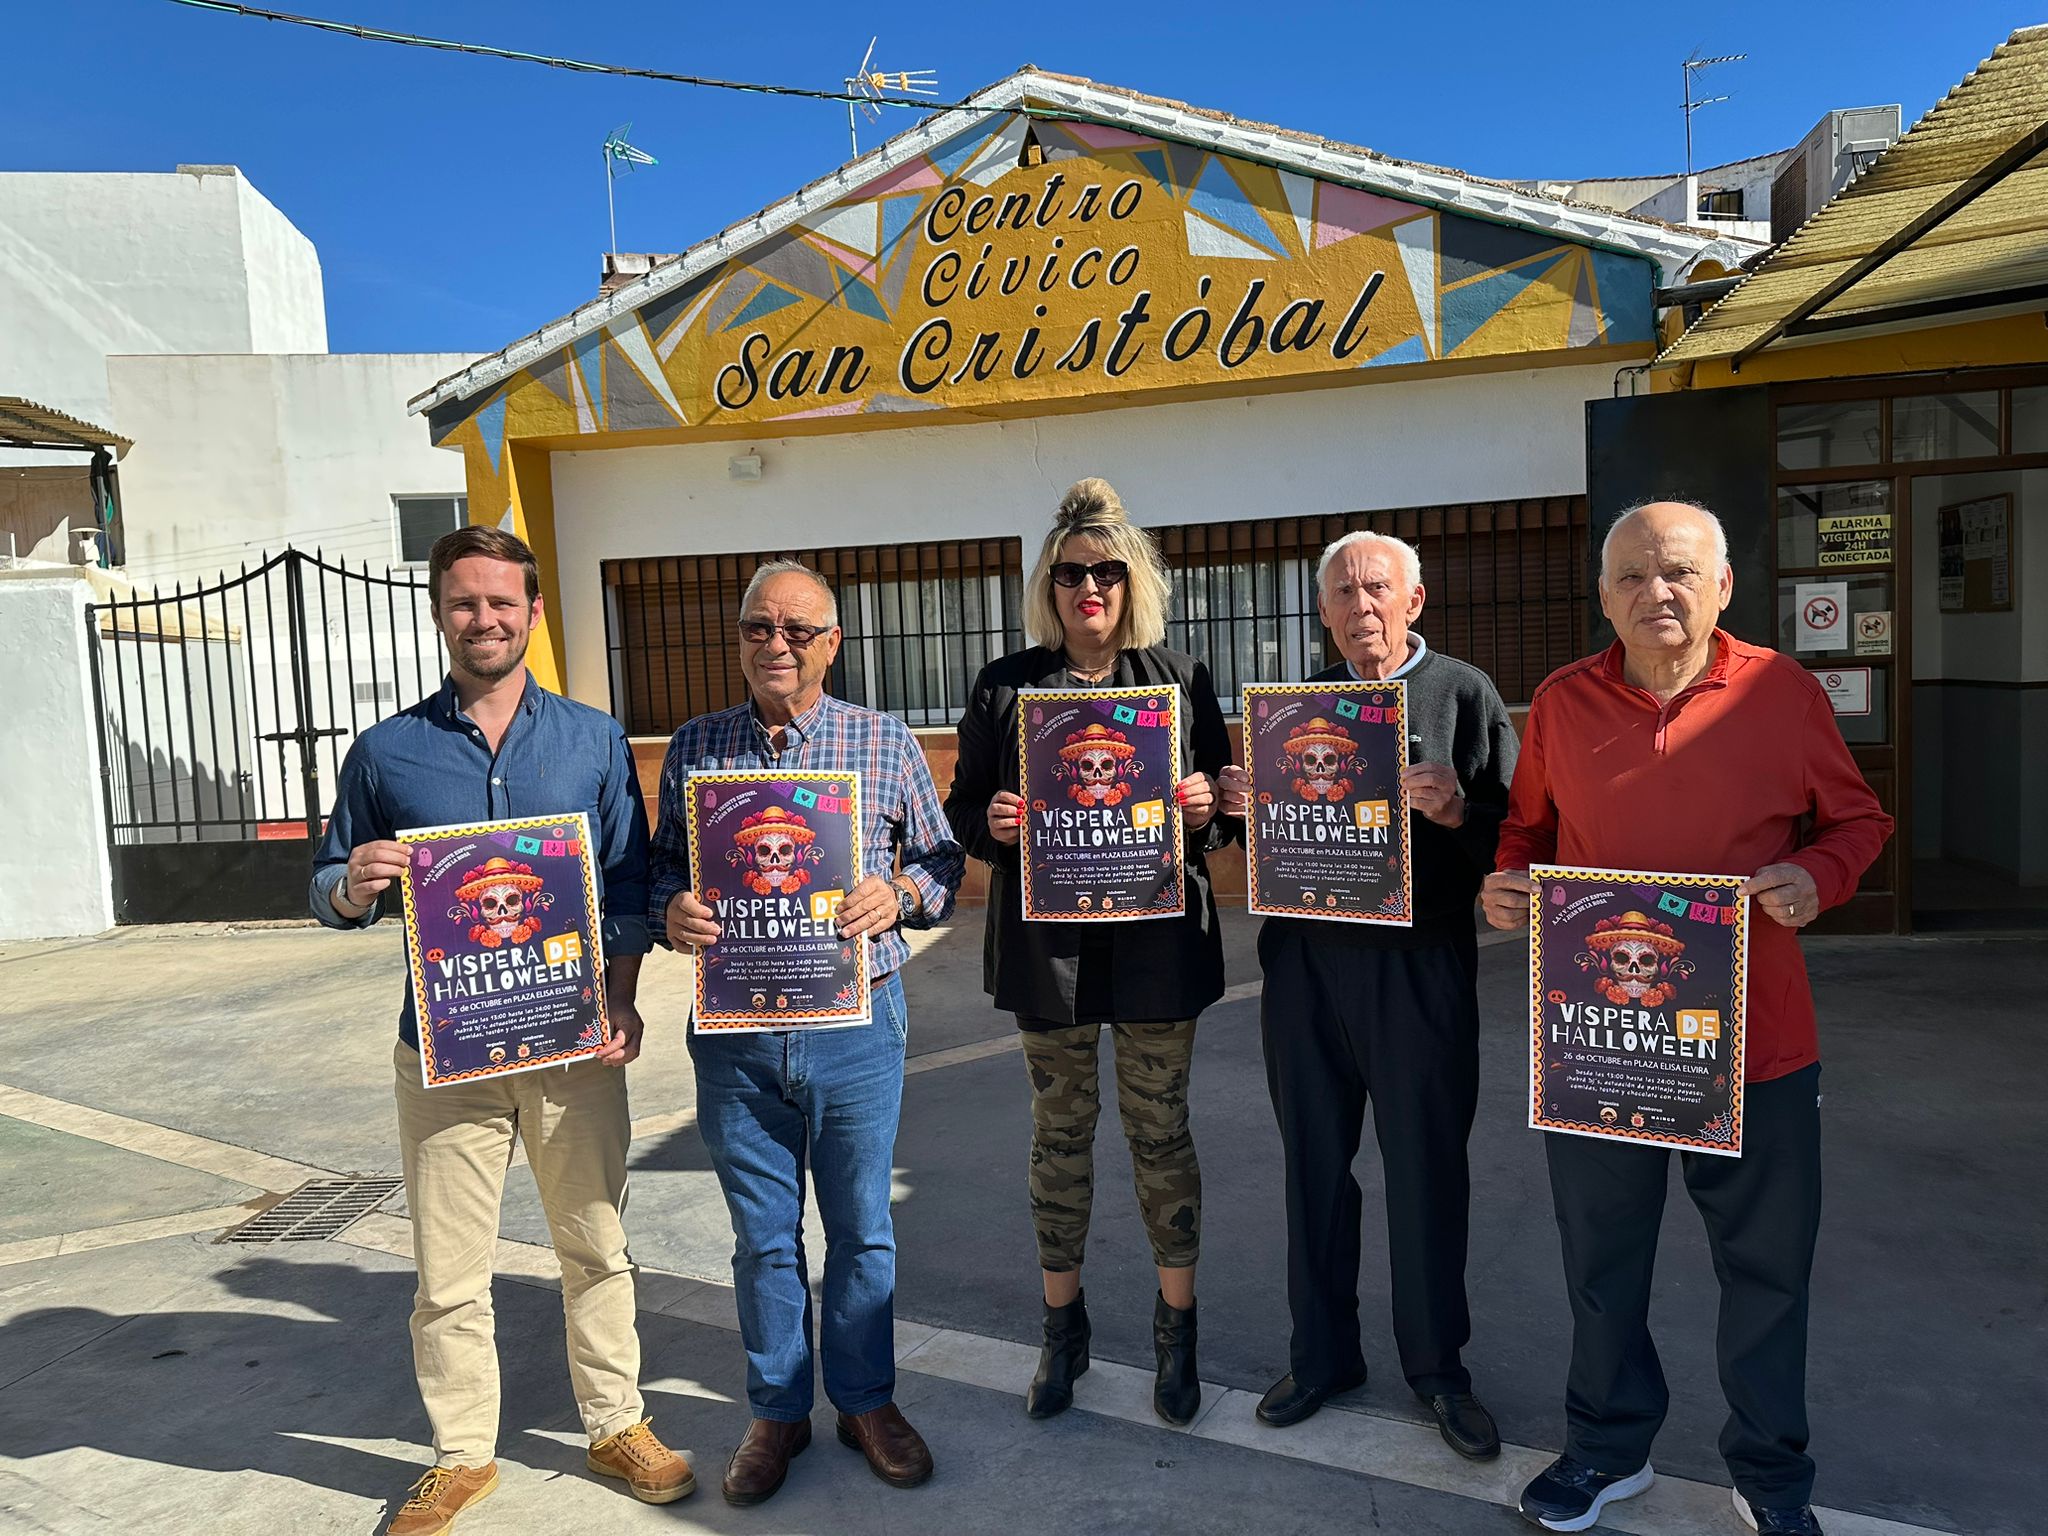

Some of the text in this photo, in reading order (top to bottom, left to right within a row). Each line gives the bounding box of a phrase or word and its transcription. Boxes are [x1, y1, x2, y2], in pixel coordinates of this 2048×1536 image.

[926, 174, 1142, 244] Centro
[924, 238, 1139, 306] Cívico
[715, 271, 1386, 410] San Cristóbal
[1830, 517, 1883, 530] ALARMA
[1821, 530, 1889, 543] VIGILANCIA
[1844, 542, 1866, 551] 24H
[1821, 551, 1890, 563] CONECTADA
[1041, 807, 1161, 828] VÍSPERA DE
[1266, 802, 1386, 824] VÍSPERA DE
[1037, 826, 1162, 847] HALLOWEEN
[1262, 823, 1388, 844] HALLOWEEN
[715, 897, 804, 918] VÍSPERA
[439, 939, 577, 977] VÍSPERA DE
[435, 959, 580, 1001] HALLOWEEN
[470, 998, 502, 1010] OCTUBRE
[513, 993, 535, 1002] PLAZA
[536, 989, 554, 998] ELISA
[555, 985, 577, 995] ELVIRA
[1560, 1001, 1715, 1036] VÍSPERA DE
[1552, 1024, 1716, 1059] HALLOWEEN
[1586, 1054, 1621, 1065] OCTUBRE
[1634, 1060, 1658, 1069] PLAZA
[1660, 1062, 1681, 1071] ELISA
[1683, 1065, 1709, 1074] ELVIRA
